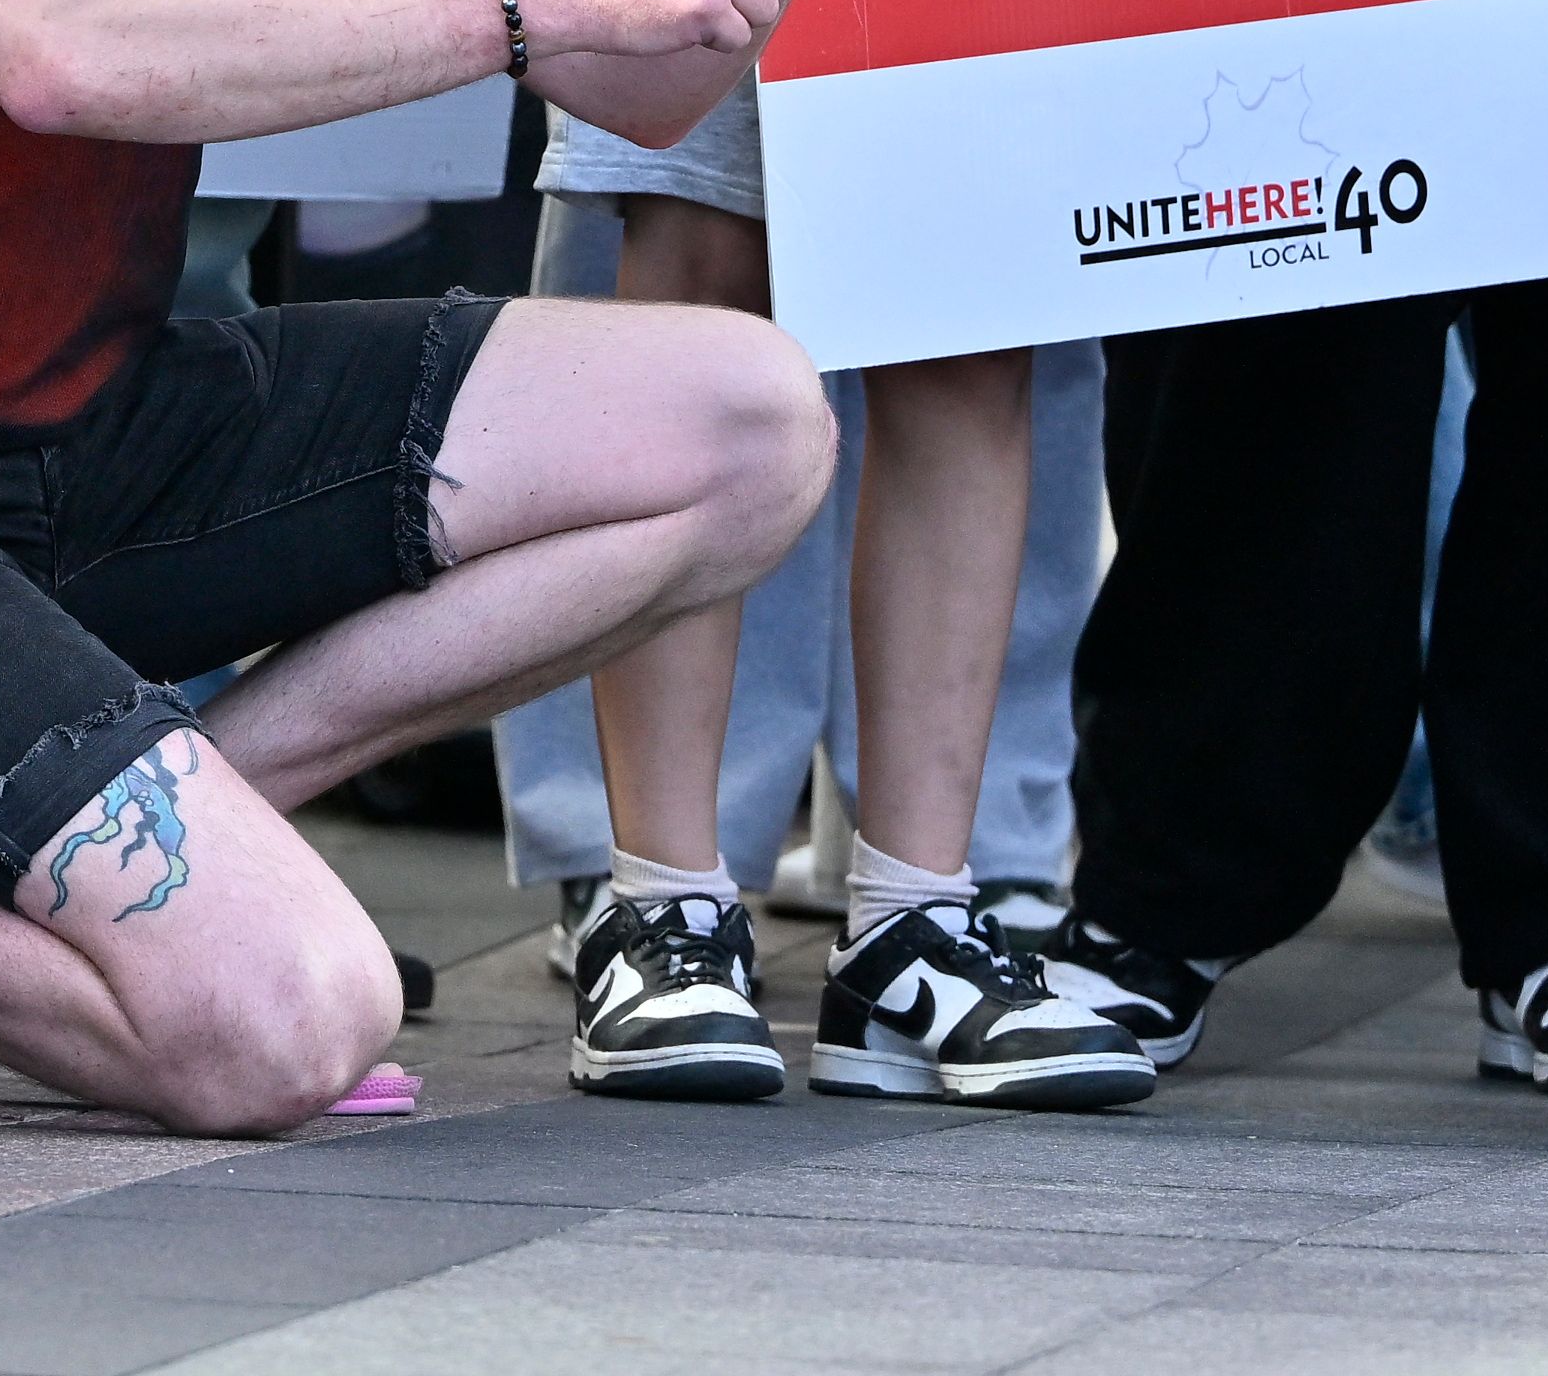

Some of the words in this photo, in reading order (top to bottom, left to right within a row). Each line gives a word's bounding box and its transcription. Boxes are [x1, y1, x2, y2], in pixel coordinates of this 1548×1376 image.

[1073, 176, 1325, 248] UNITEHERE!
[1334, 157, 1429, 255] 40
[1248, 241, 1330, 270] LOCAL
